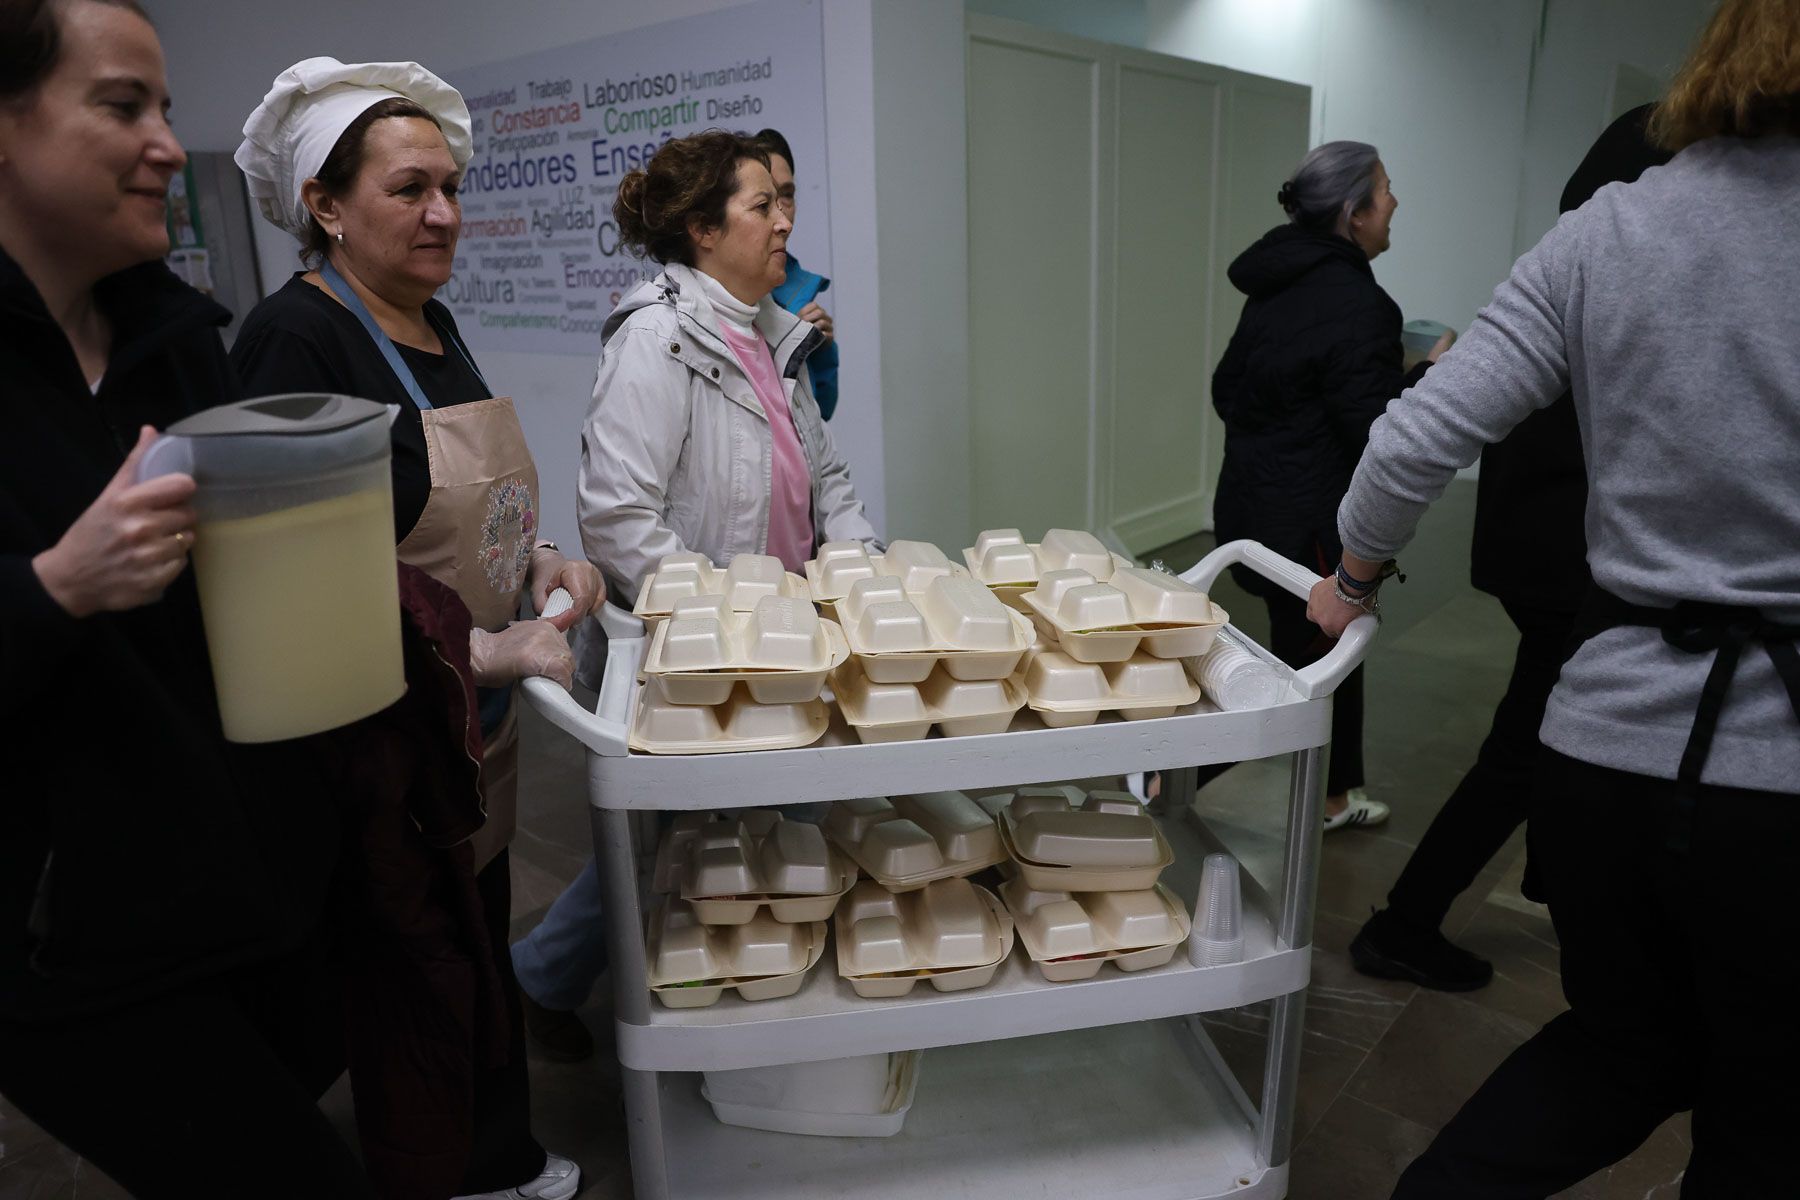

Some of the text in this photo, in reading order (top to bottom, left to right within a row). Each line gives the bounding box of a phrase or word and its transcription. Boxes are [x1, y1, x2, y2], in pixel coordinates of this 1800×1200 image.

[681, 56, 772, 92] Humanidad
[465, 86, 516, 112] onalidad
[527, 77, 572, 101] Trabajo
[584, 73, 676, 109] Laborioso
[492, 101, 581, 134] Constancia
[604, 97, 700, 137] Compartir
[706, 94, 762, 121] Diseño
[488, 130, 559, 154] Participación
[592, 132, 671, 177] Ense
[531, 204, 595, 237] Agilidad
[480, 253, 543, 274] Imaginación
[564, 262, 640, 289] Emoción
[446, 273, 515, 304] Cultura
[559, 313, 603, 334] Conoci
